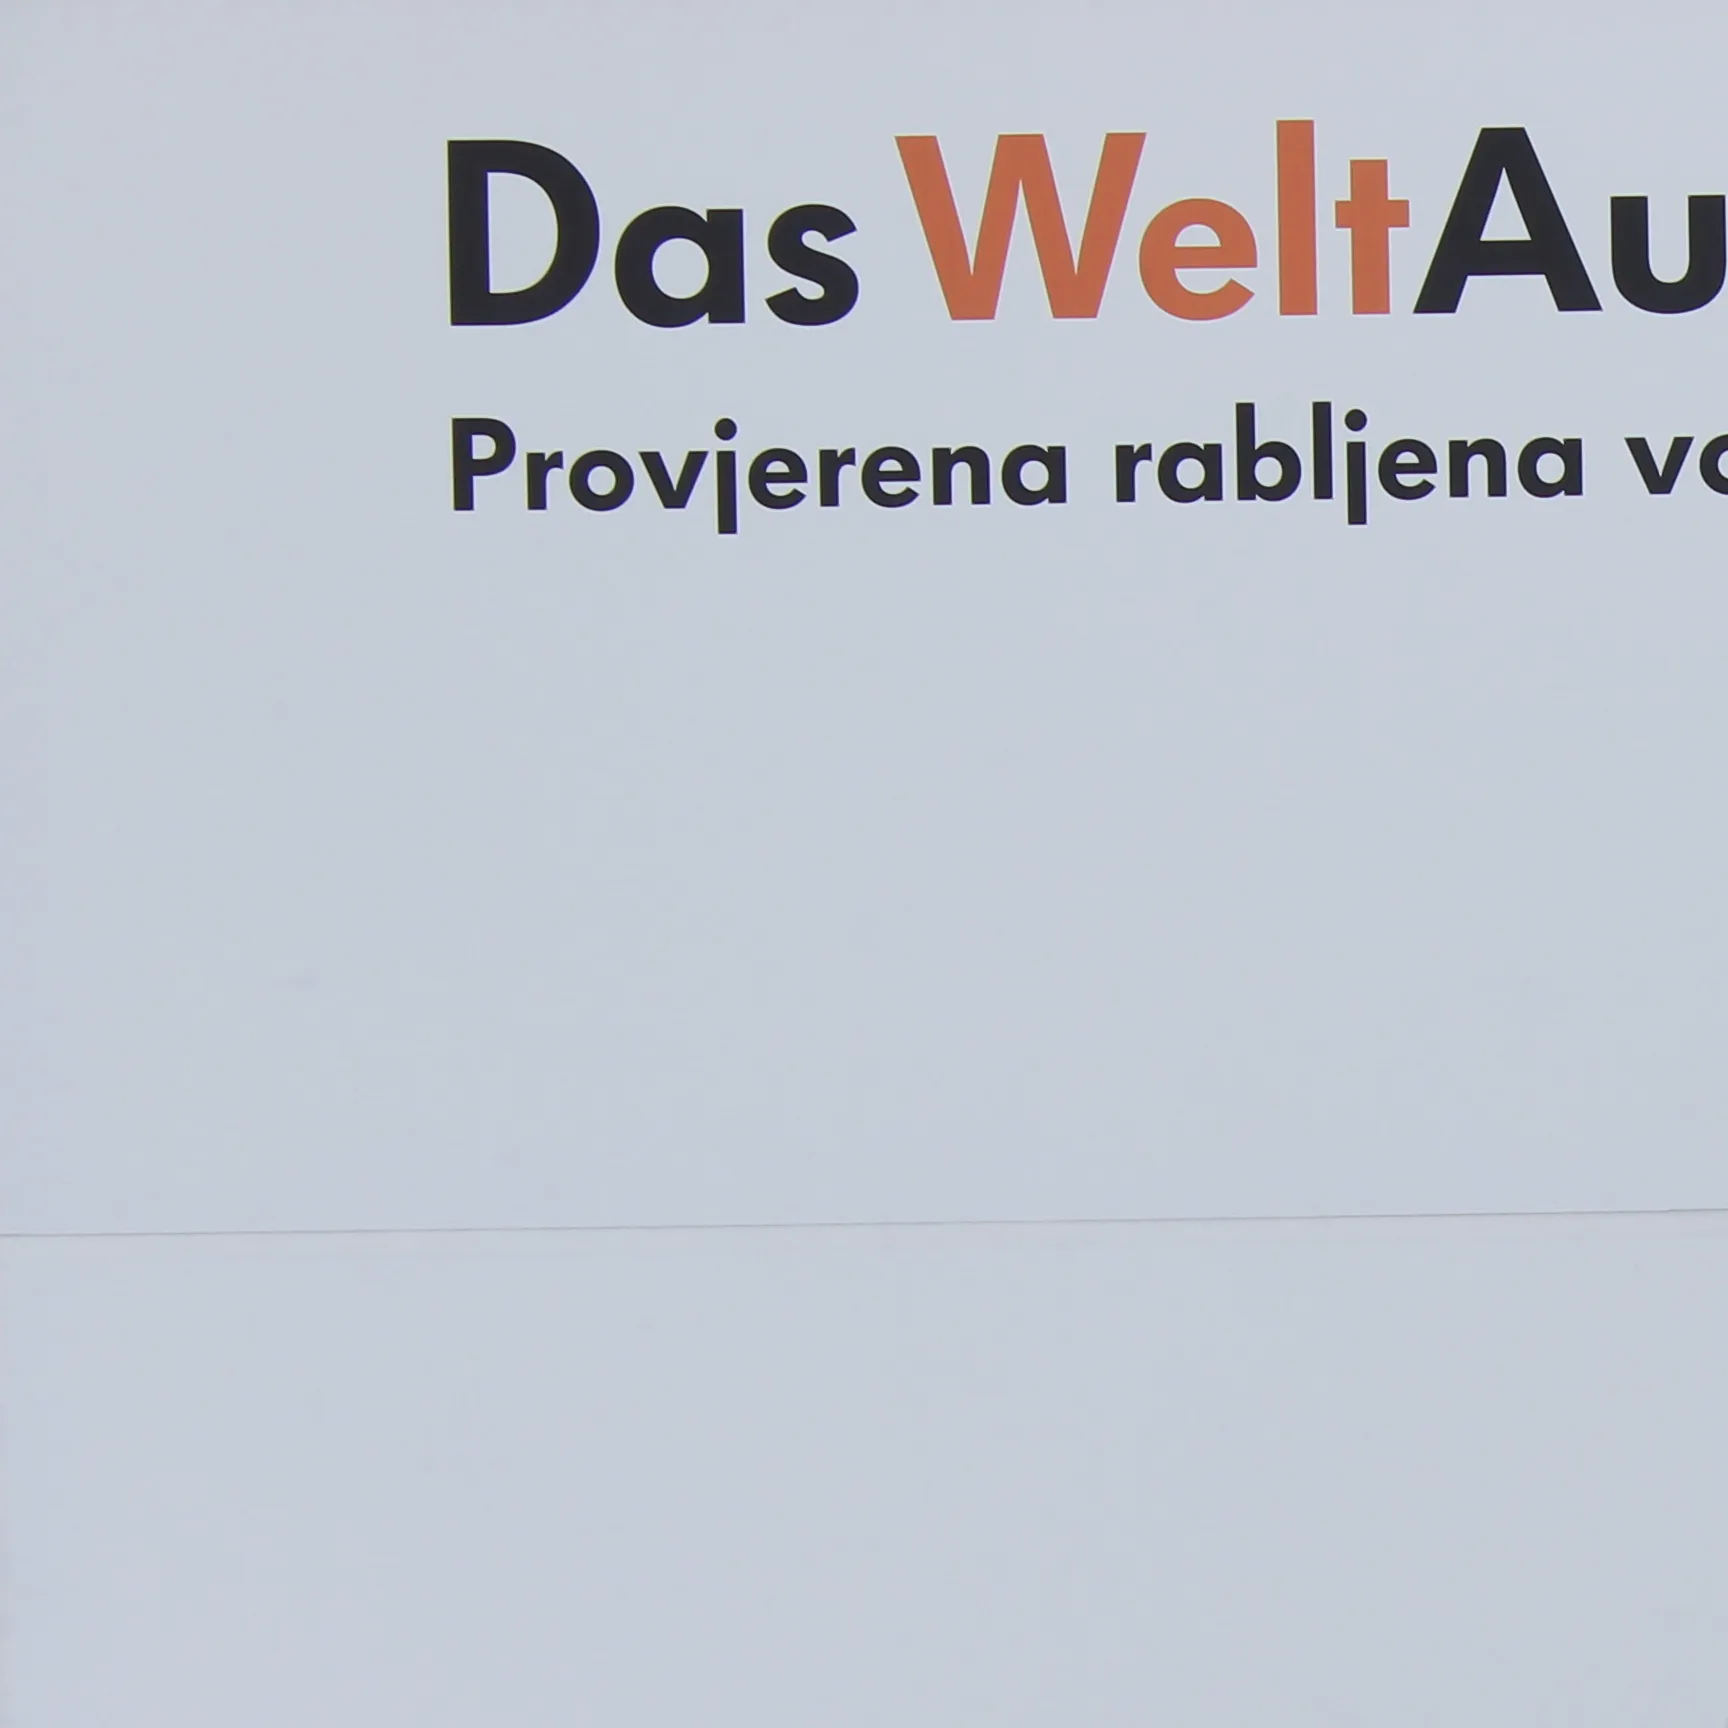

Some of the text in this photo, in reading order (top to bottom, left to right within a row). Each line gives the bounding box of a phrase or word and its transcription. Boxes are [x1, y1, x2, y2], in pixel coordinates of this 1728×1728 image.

[447, 139, 859, 328] Das
[451, 417, 1067, 535] Provjerena
[1115, 401, 1584, 526] rabljena
